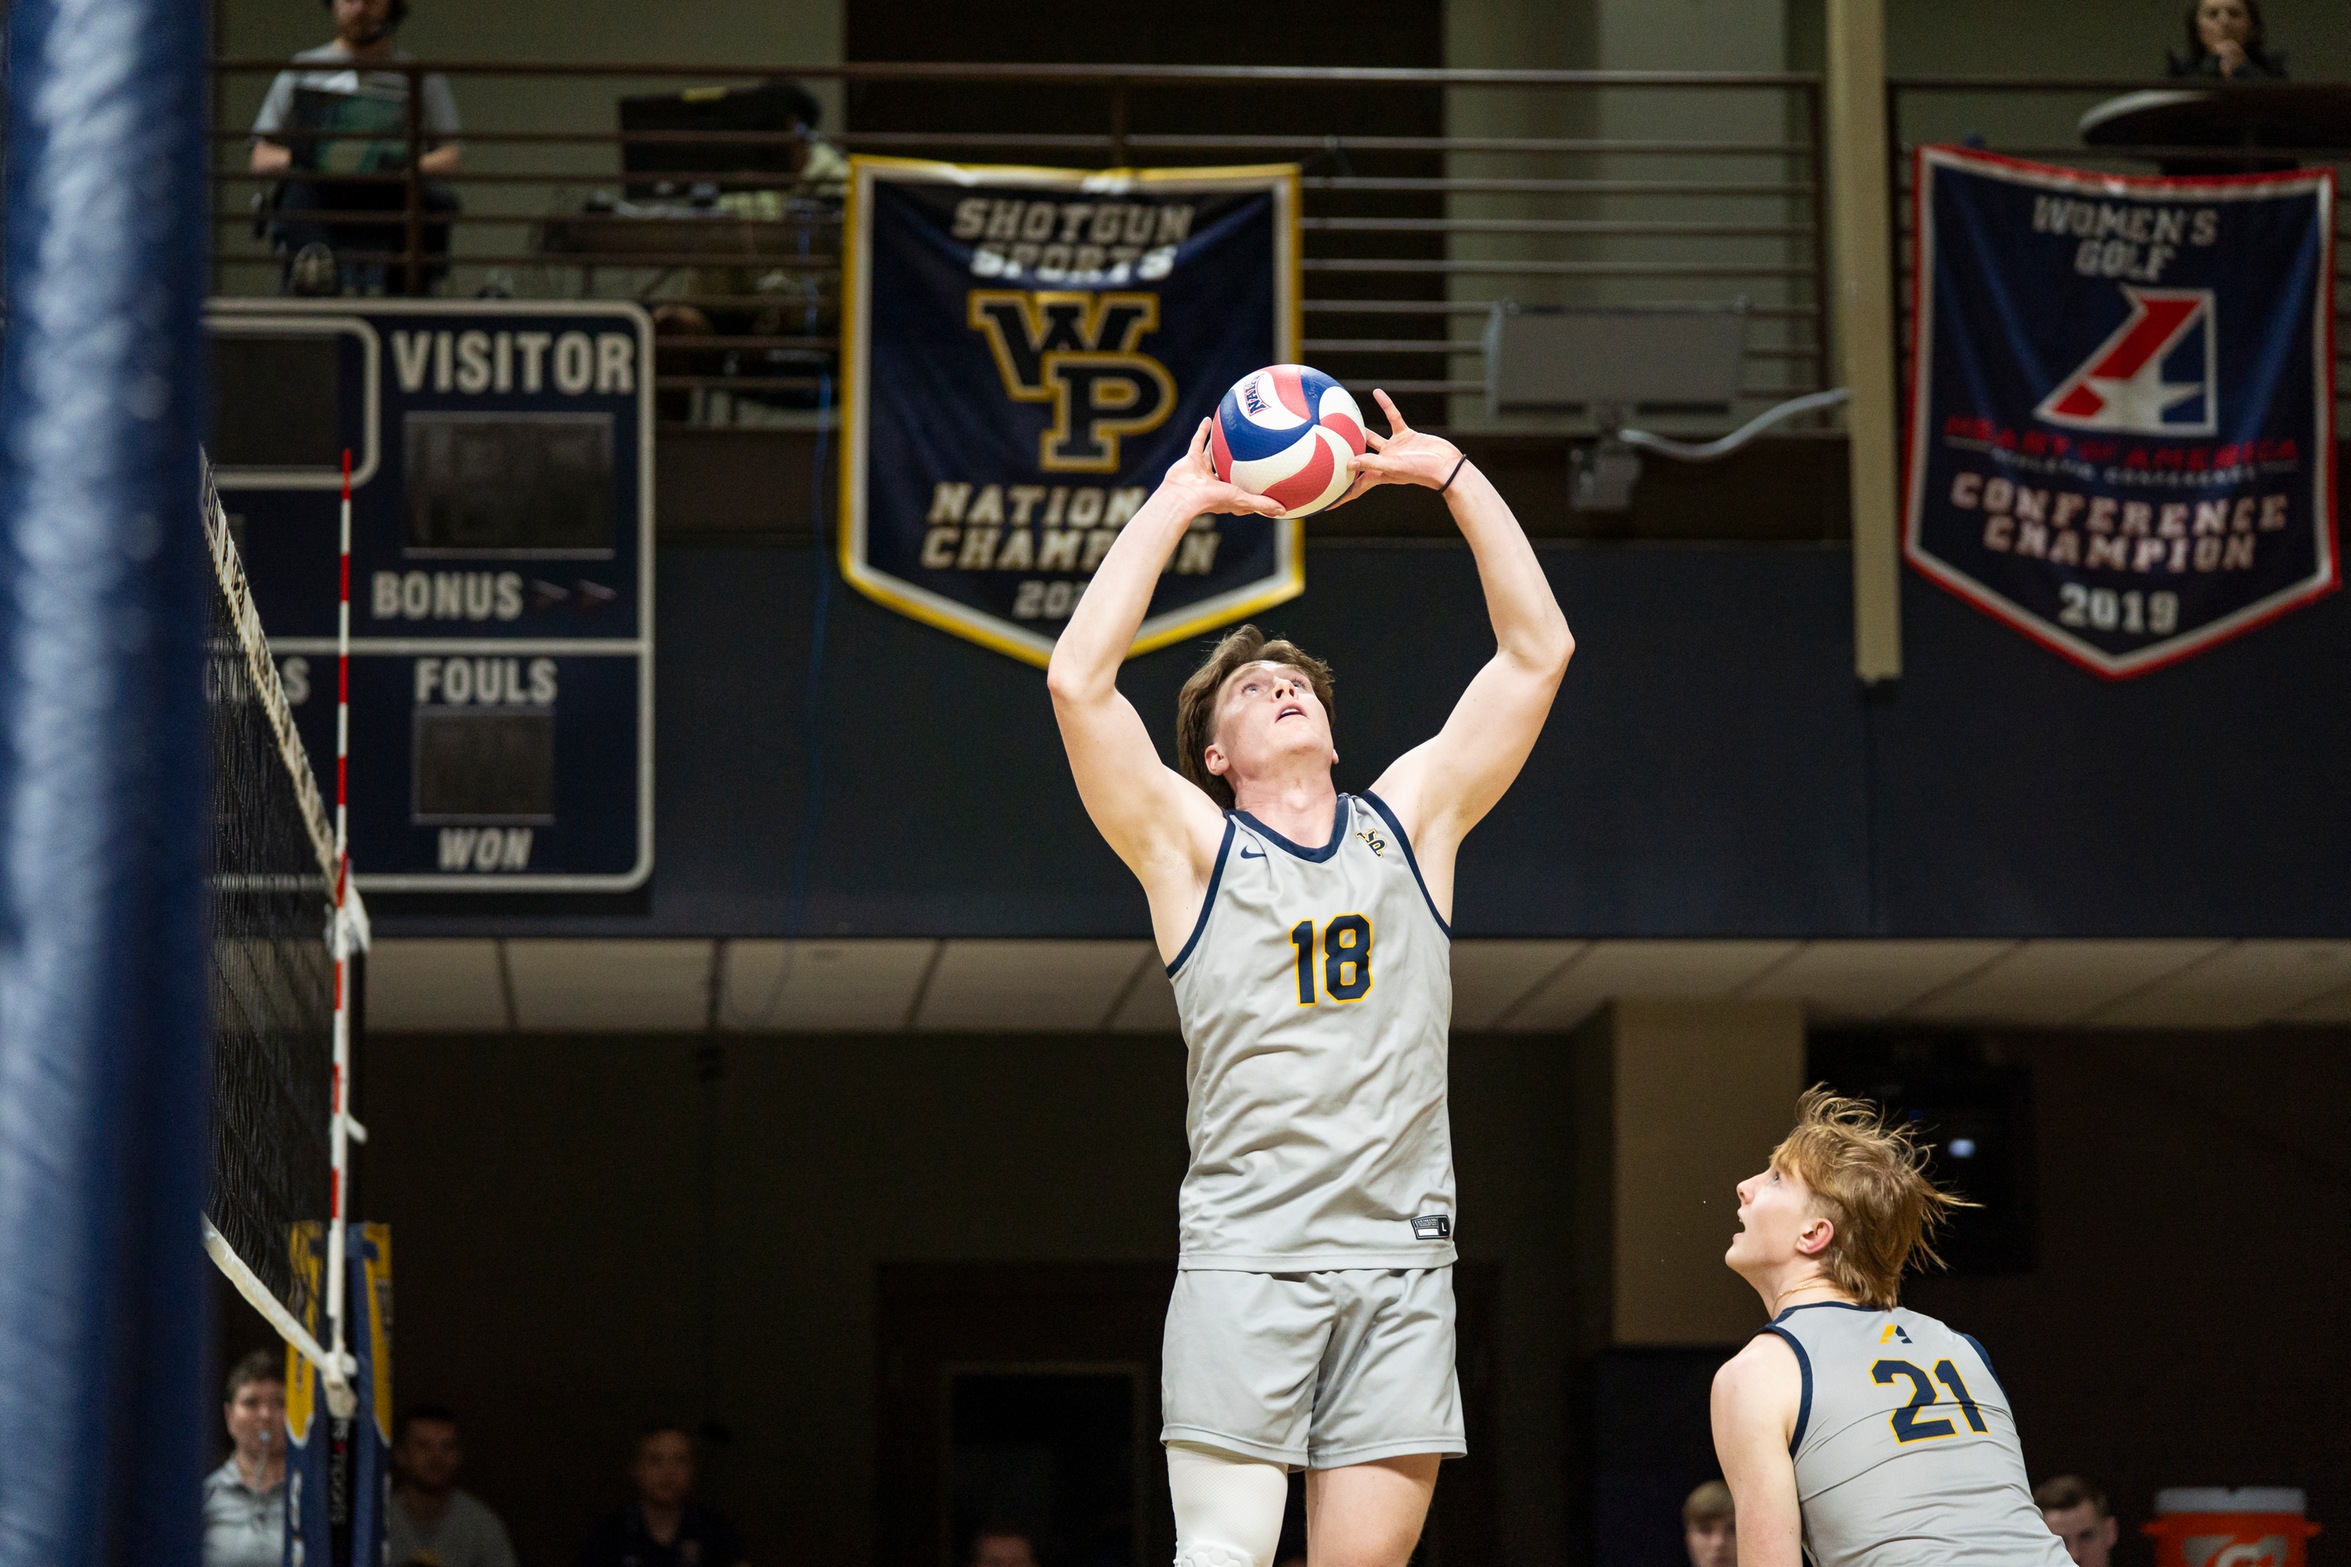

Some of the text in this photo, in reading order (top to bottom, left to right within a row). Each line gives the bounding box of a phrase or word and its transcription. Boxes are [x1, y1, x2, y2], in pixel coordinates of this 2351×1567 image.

[953, 199, 1195, 243] SHOTGUN
[2033, 196, 2217, 246] WOMEN'S
[969, 242, 1179, 282] SPORTS
[2074, 239, 2177, 281] GOLF
[391, 332, 634, 394] VISITOR
[926, 482, 1216, 531] NATION
[1950, 472, 2288, 538] CONFERENCE
[920, 526, 1222, 576] CHAMPN
[1982, 513, 2257, 573] CHAMPION
[371, 571, 524, 620] BONUS
[1012, 580, 1086, 620] 20
[2057, 582, 2180, 634] 2019
[414, 658, 558, 703] FOULS
[437, 828, 533, 871] WON
[1290, 912, 1374, 1006] 18
[1441, 1222, 1447, 1231] L
[1870, 1358, 1989, 1444] 21
